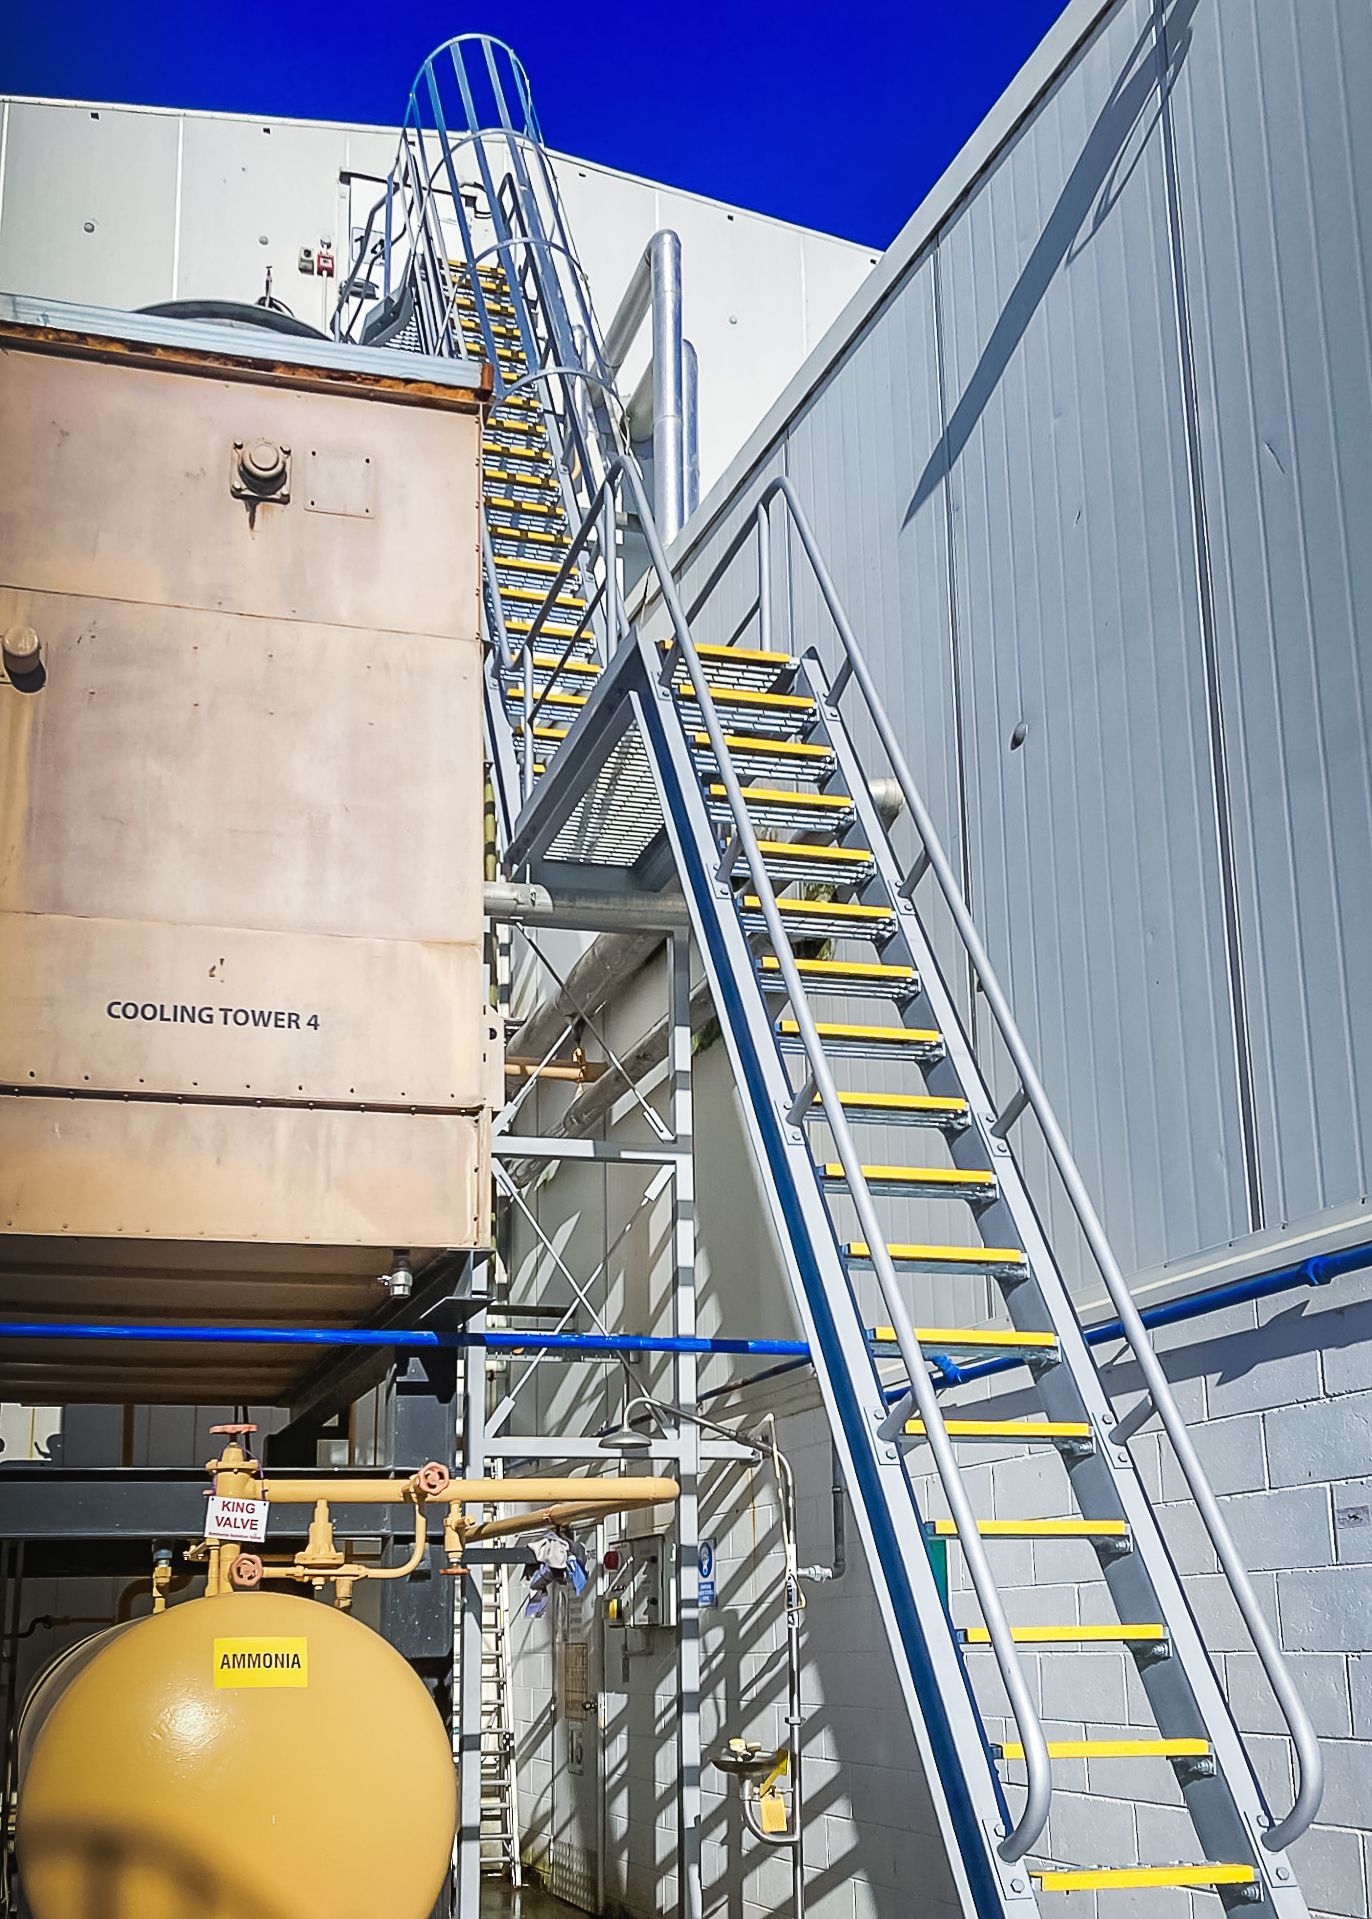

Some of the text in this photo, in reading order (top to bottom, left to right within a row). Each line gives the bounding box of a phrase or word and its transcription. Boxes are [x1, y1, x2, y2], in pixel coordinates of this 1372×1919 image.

[106, 1001, 320, 1031] COOLING TOWER 4
[221, 1500, 256, 1514] KING
[215, 1515, 259, 1531] VALVE
[220, 1652, 302, 1670] AMMONIA
